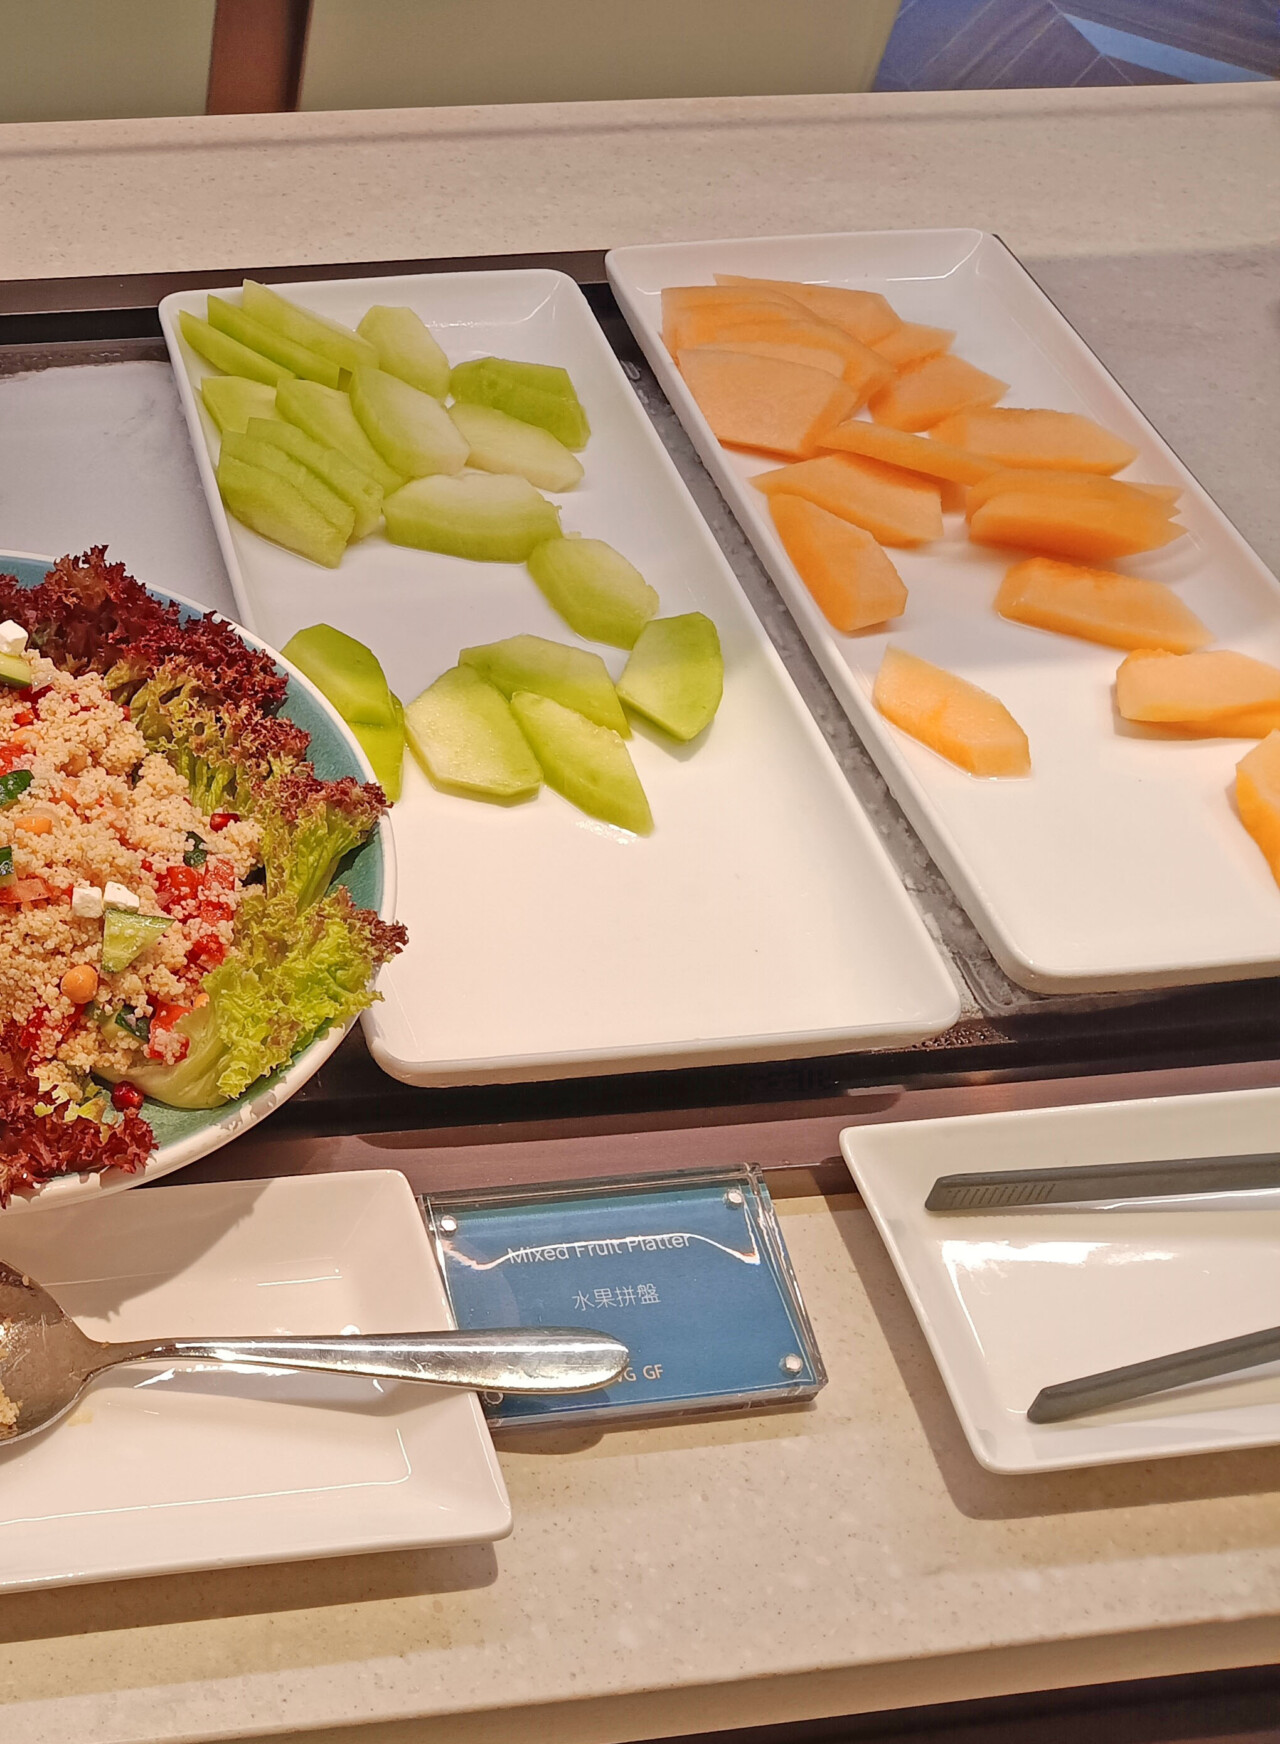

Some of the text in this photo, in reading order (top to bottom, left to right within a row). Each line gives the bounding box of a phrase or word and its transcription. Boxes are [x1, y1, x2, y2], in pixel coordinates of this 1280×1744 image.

[507, 1235, 690, 1264] Mixed Fruit Platter
[571, 1283, 661, 1312] 水果拼盤
[643, 1363, 663, 1380] GF
